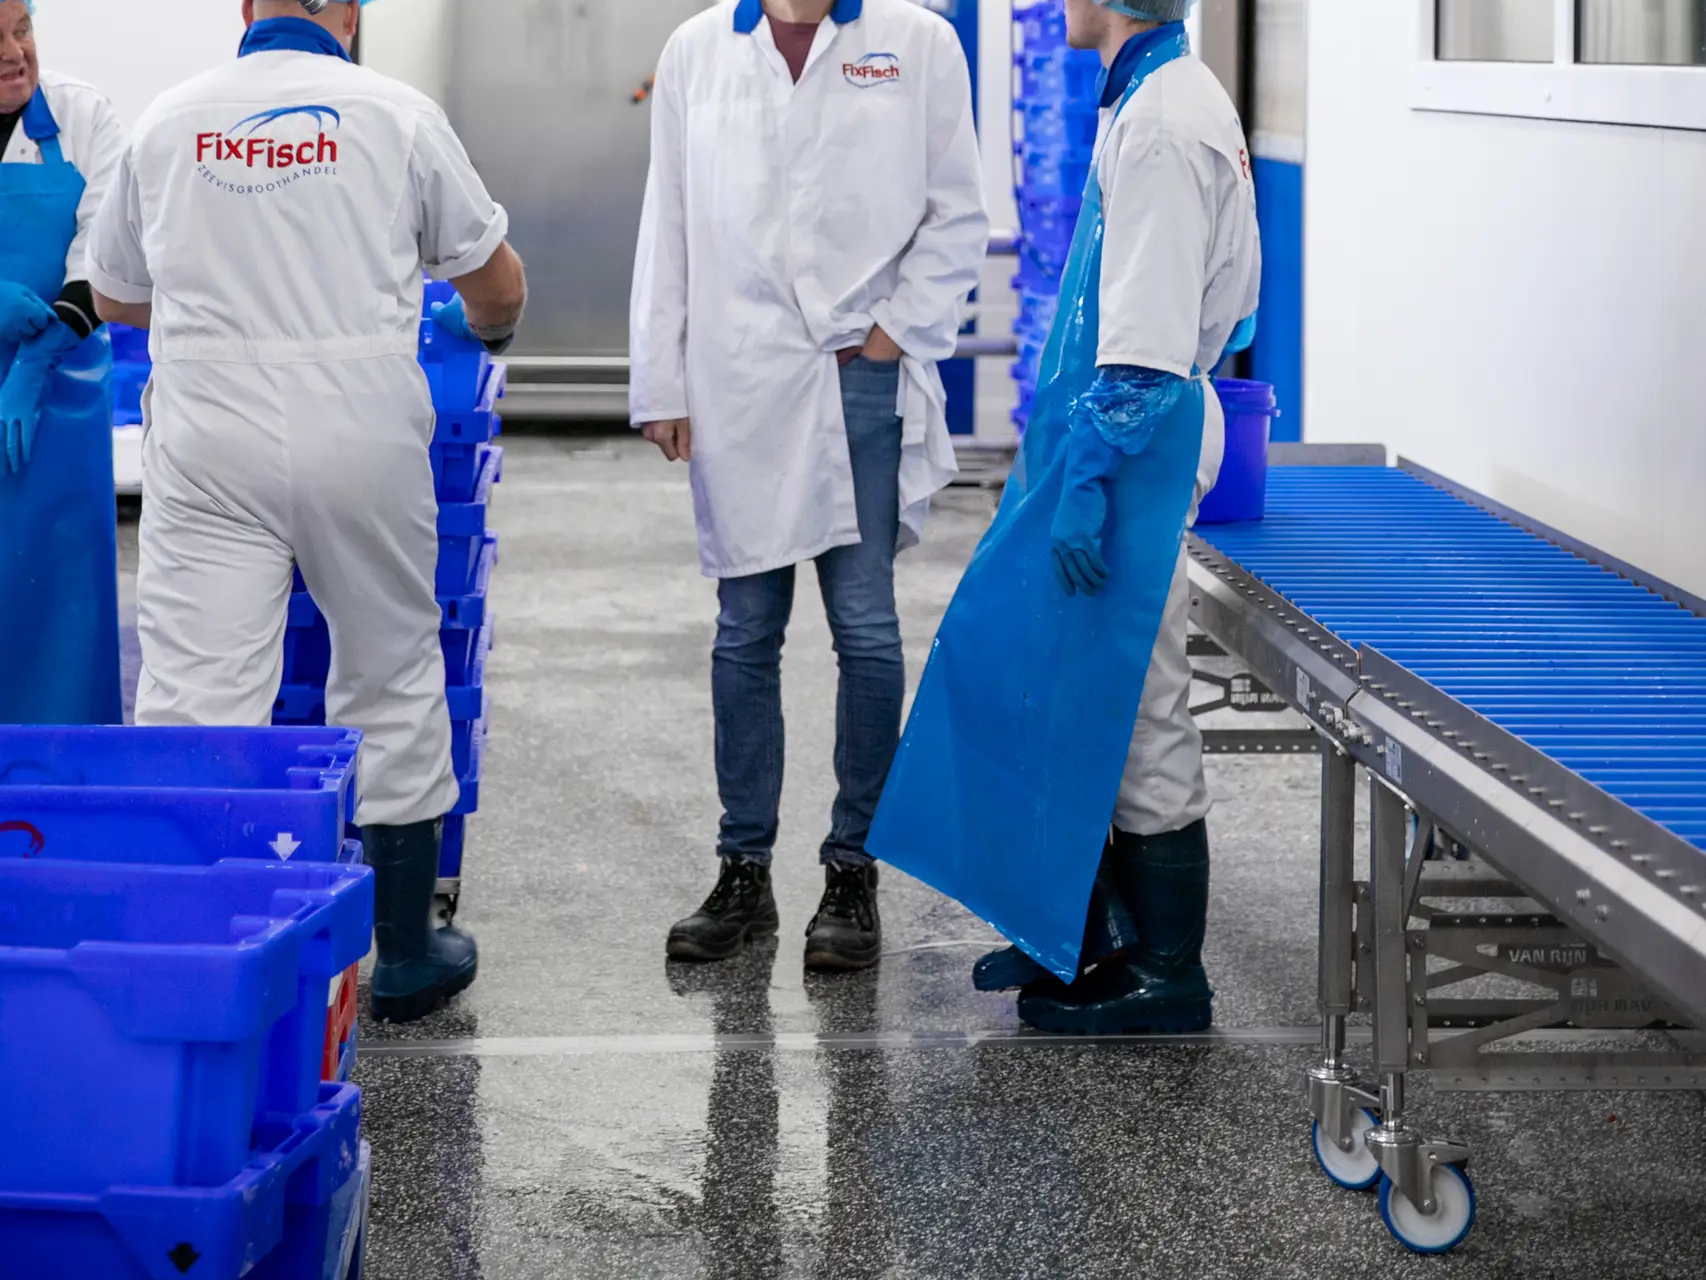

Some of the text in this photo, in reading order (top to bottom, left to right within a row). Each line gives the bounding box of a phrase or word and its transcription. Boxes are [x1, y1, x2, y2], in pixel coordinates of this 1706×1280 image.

[842, 63, 900, 79] FixFisch
[196, 131, 338, 169] FixFisch
[197, 164, 338, 195] ZEEVISGROOTHANDEL
[1508, 949, 1545, 963] VAN
